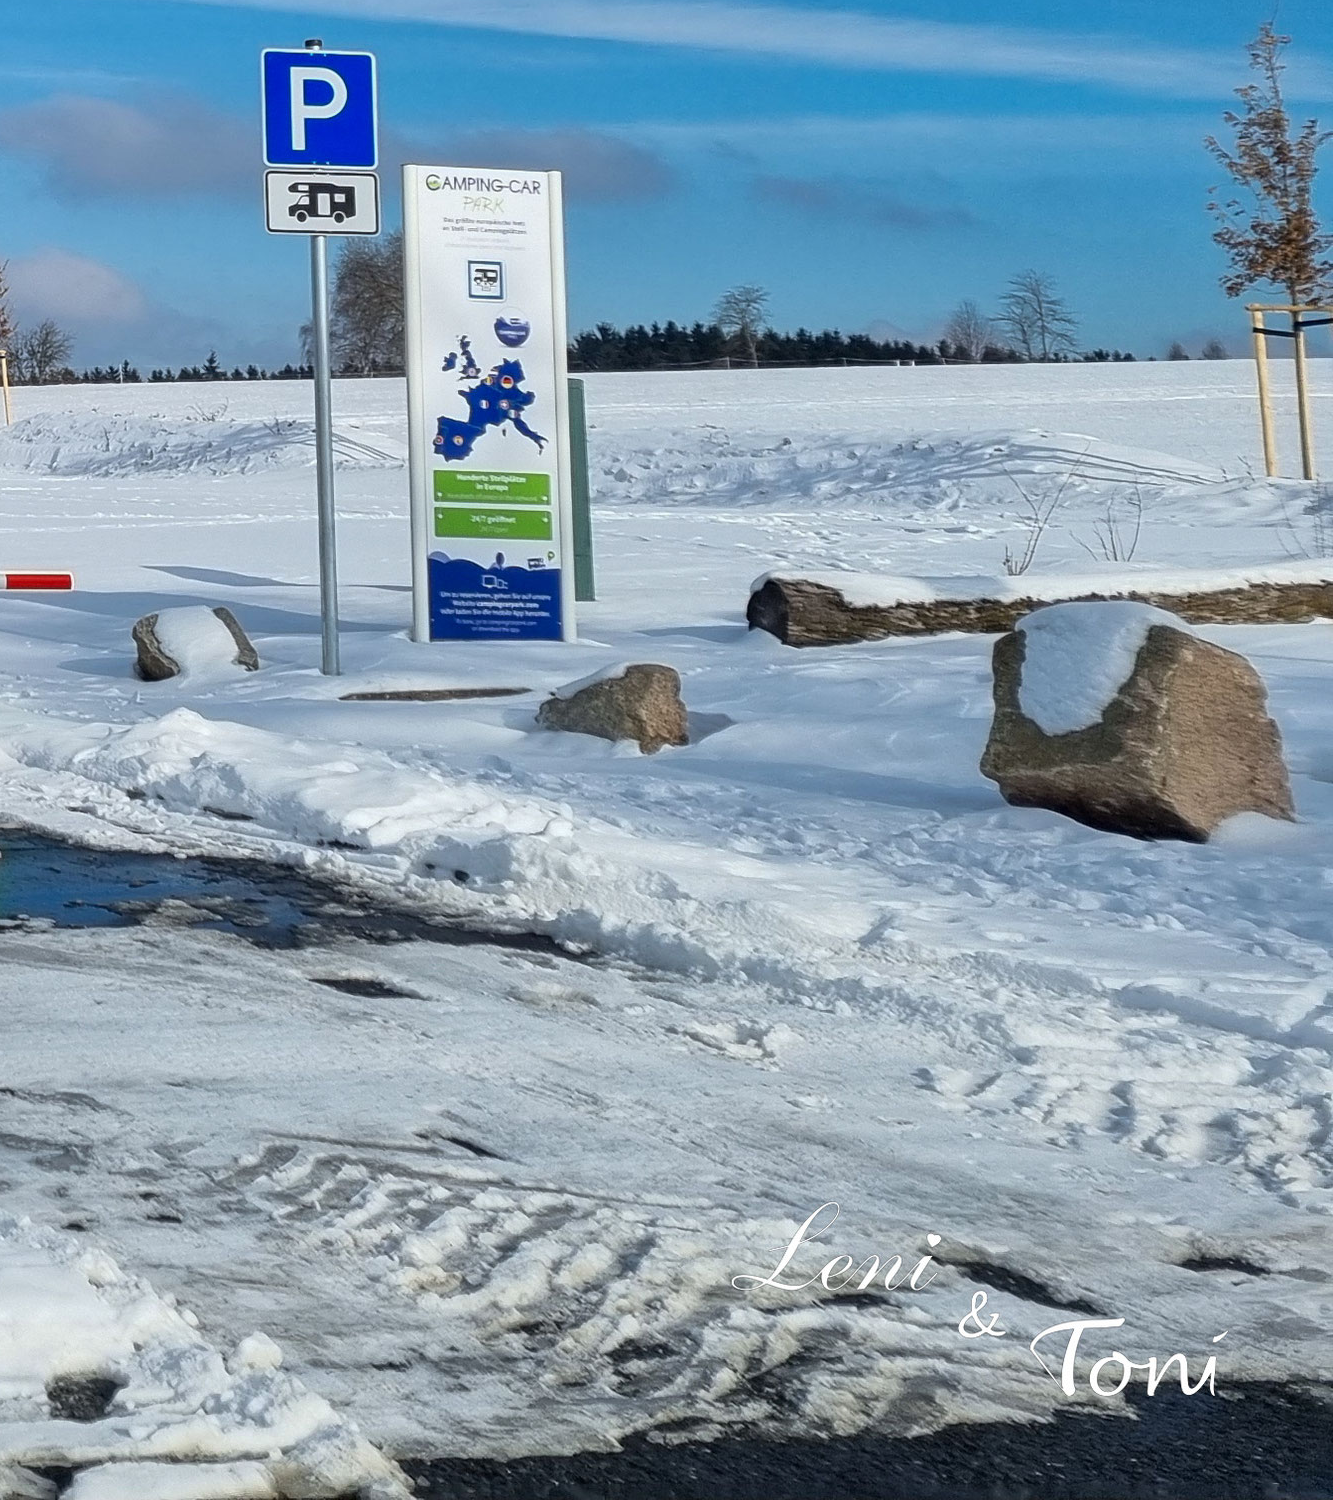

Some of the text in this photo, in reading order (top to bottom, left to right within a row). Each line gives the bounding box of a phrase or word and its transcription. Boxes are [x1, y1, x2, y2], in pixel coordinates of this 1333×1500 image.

[290, 66, 348, 151] P
[426, 174, 541, 195] CAMPING-CAR
[463, 196, 504, 213] PARK
